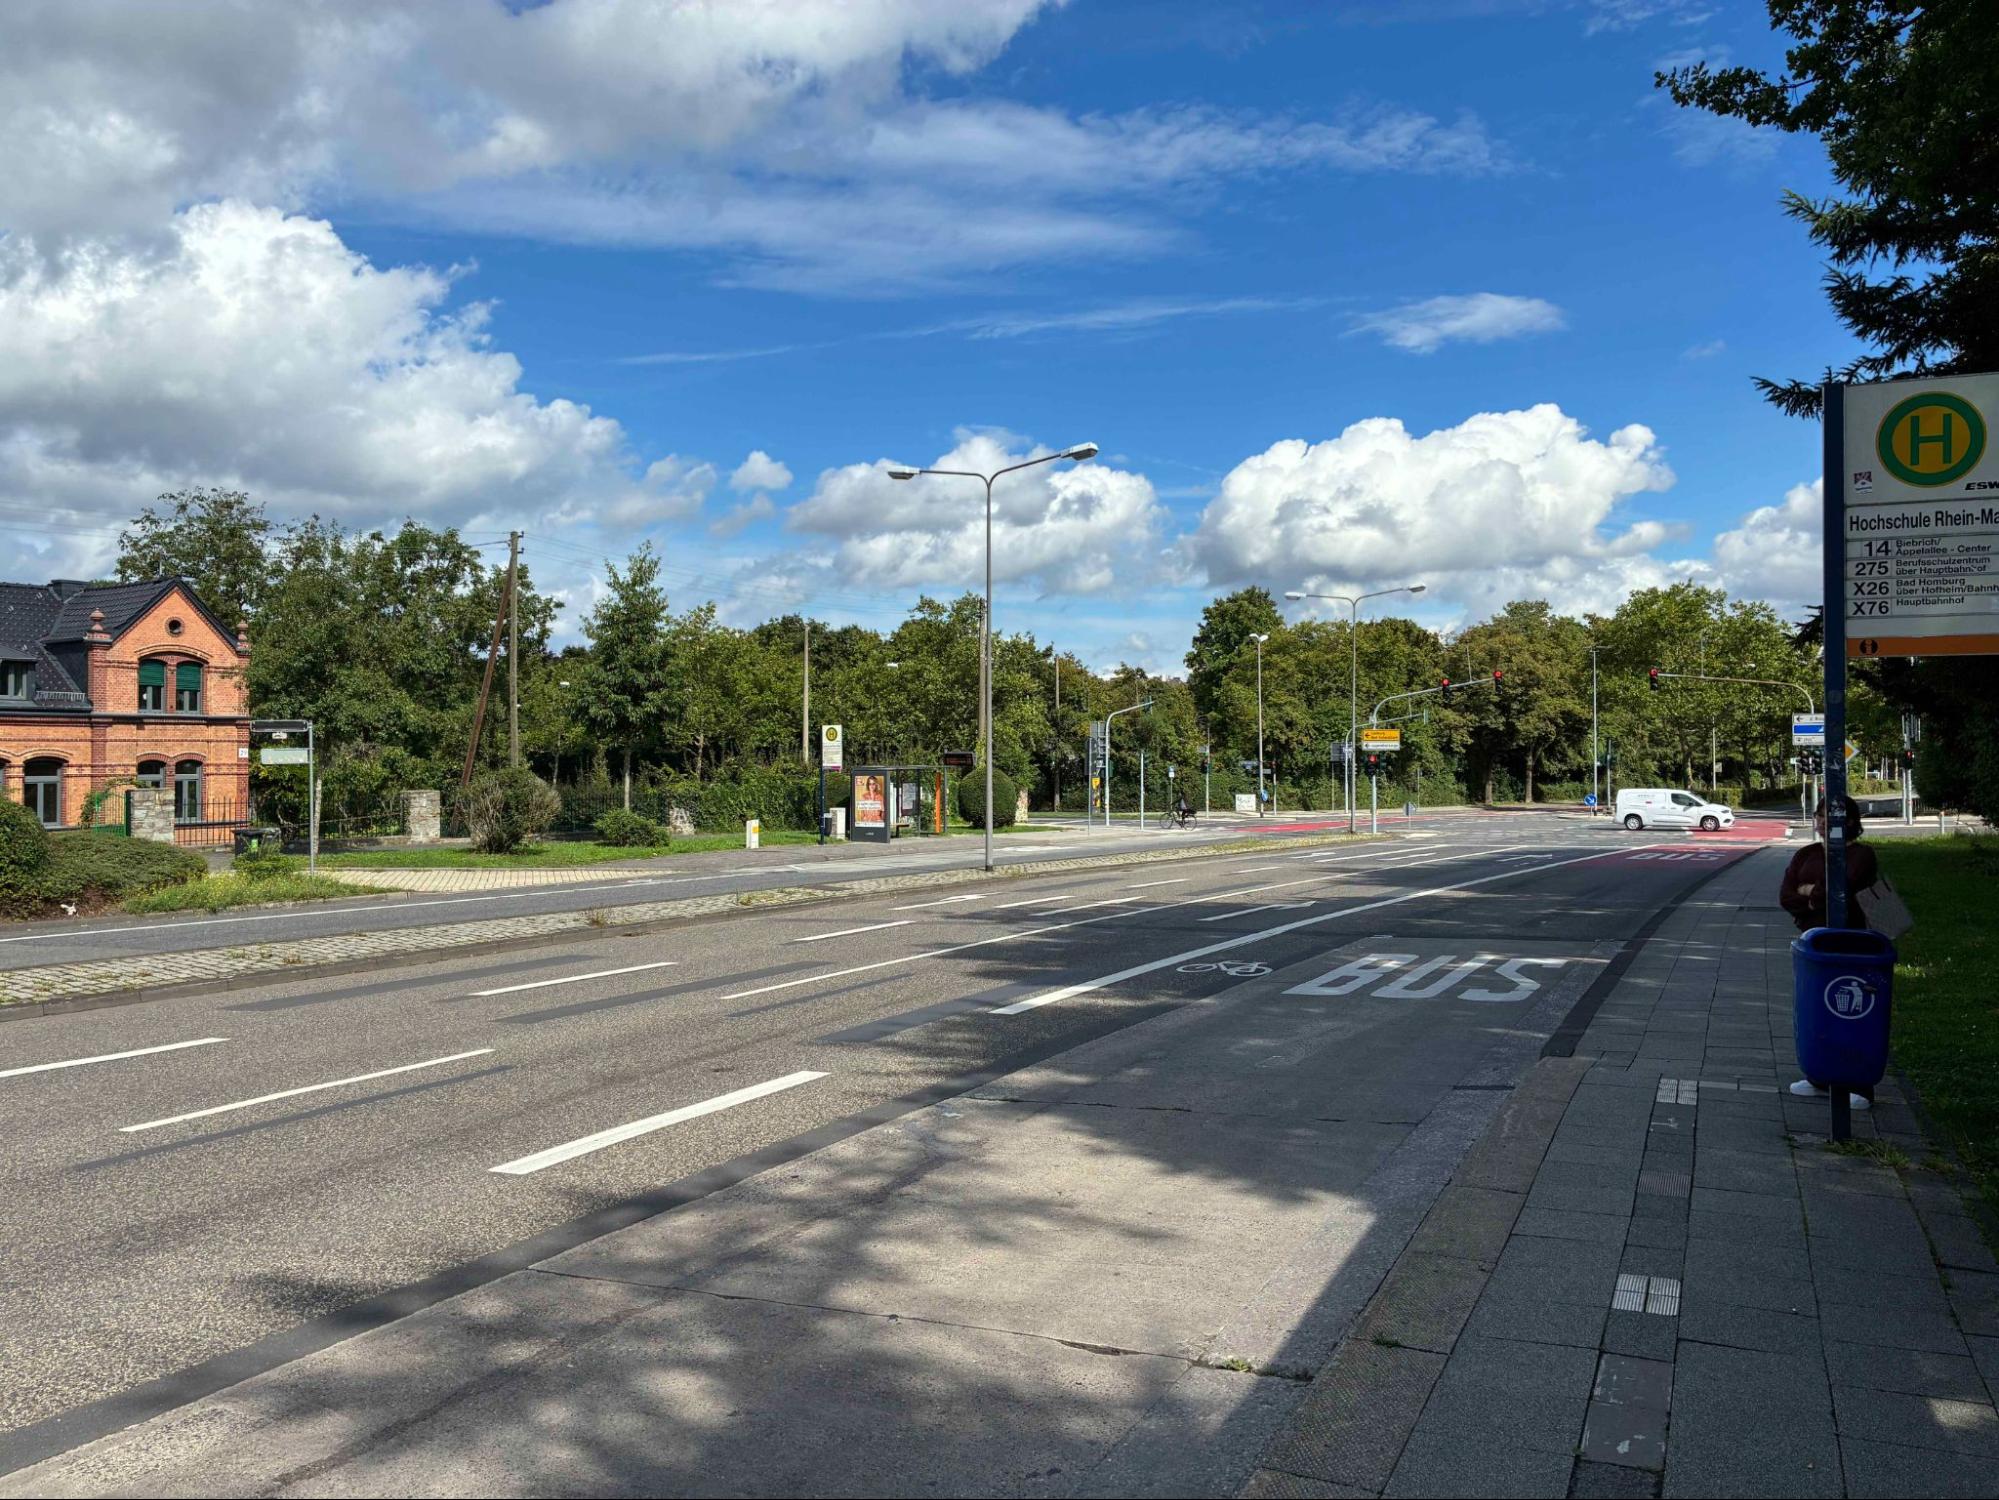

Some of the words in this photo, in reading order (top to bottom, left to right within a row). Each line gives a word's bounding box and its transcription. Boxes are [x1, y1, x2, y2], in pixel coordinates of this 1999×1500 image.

[1910, 413, 1952, 466] H
[1849, 512, 1931, 531] Hochschule
[1935, 508, 1999, 527] Rhein-Ma
[1864, 541, 1891, 556] 14
[1896, 538, 1941, 548] Biebrich/
[1896, 546, 1948, 556] Appelallee
[1957, 544, 1991, 553] Center
[1855, 561, 1889, 576] 275
[1896, 557, 1990, 567] Berufsschulzentrum
[1896, 567, 1918, 575] über
[1853, 581, 1889, 595] X26
[1896, 579, 1916, 587] Bad
[1919, 578, 1966, 586] Homburg
[1852, 601, 1889, 615] X76
[1896, 597, 1965, 607] Hauptbahnhof
[1281, 953, 1568, 1002] BUS
